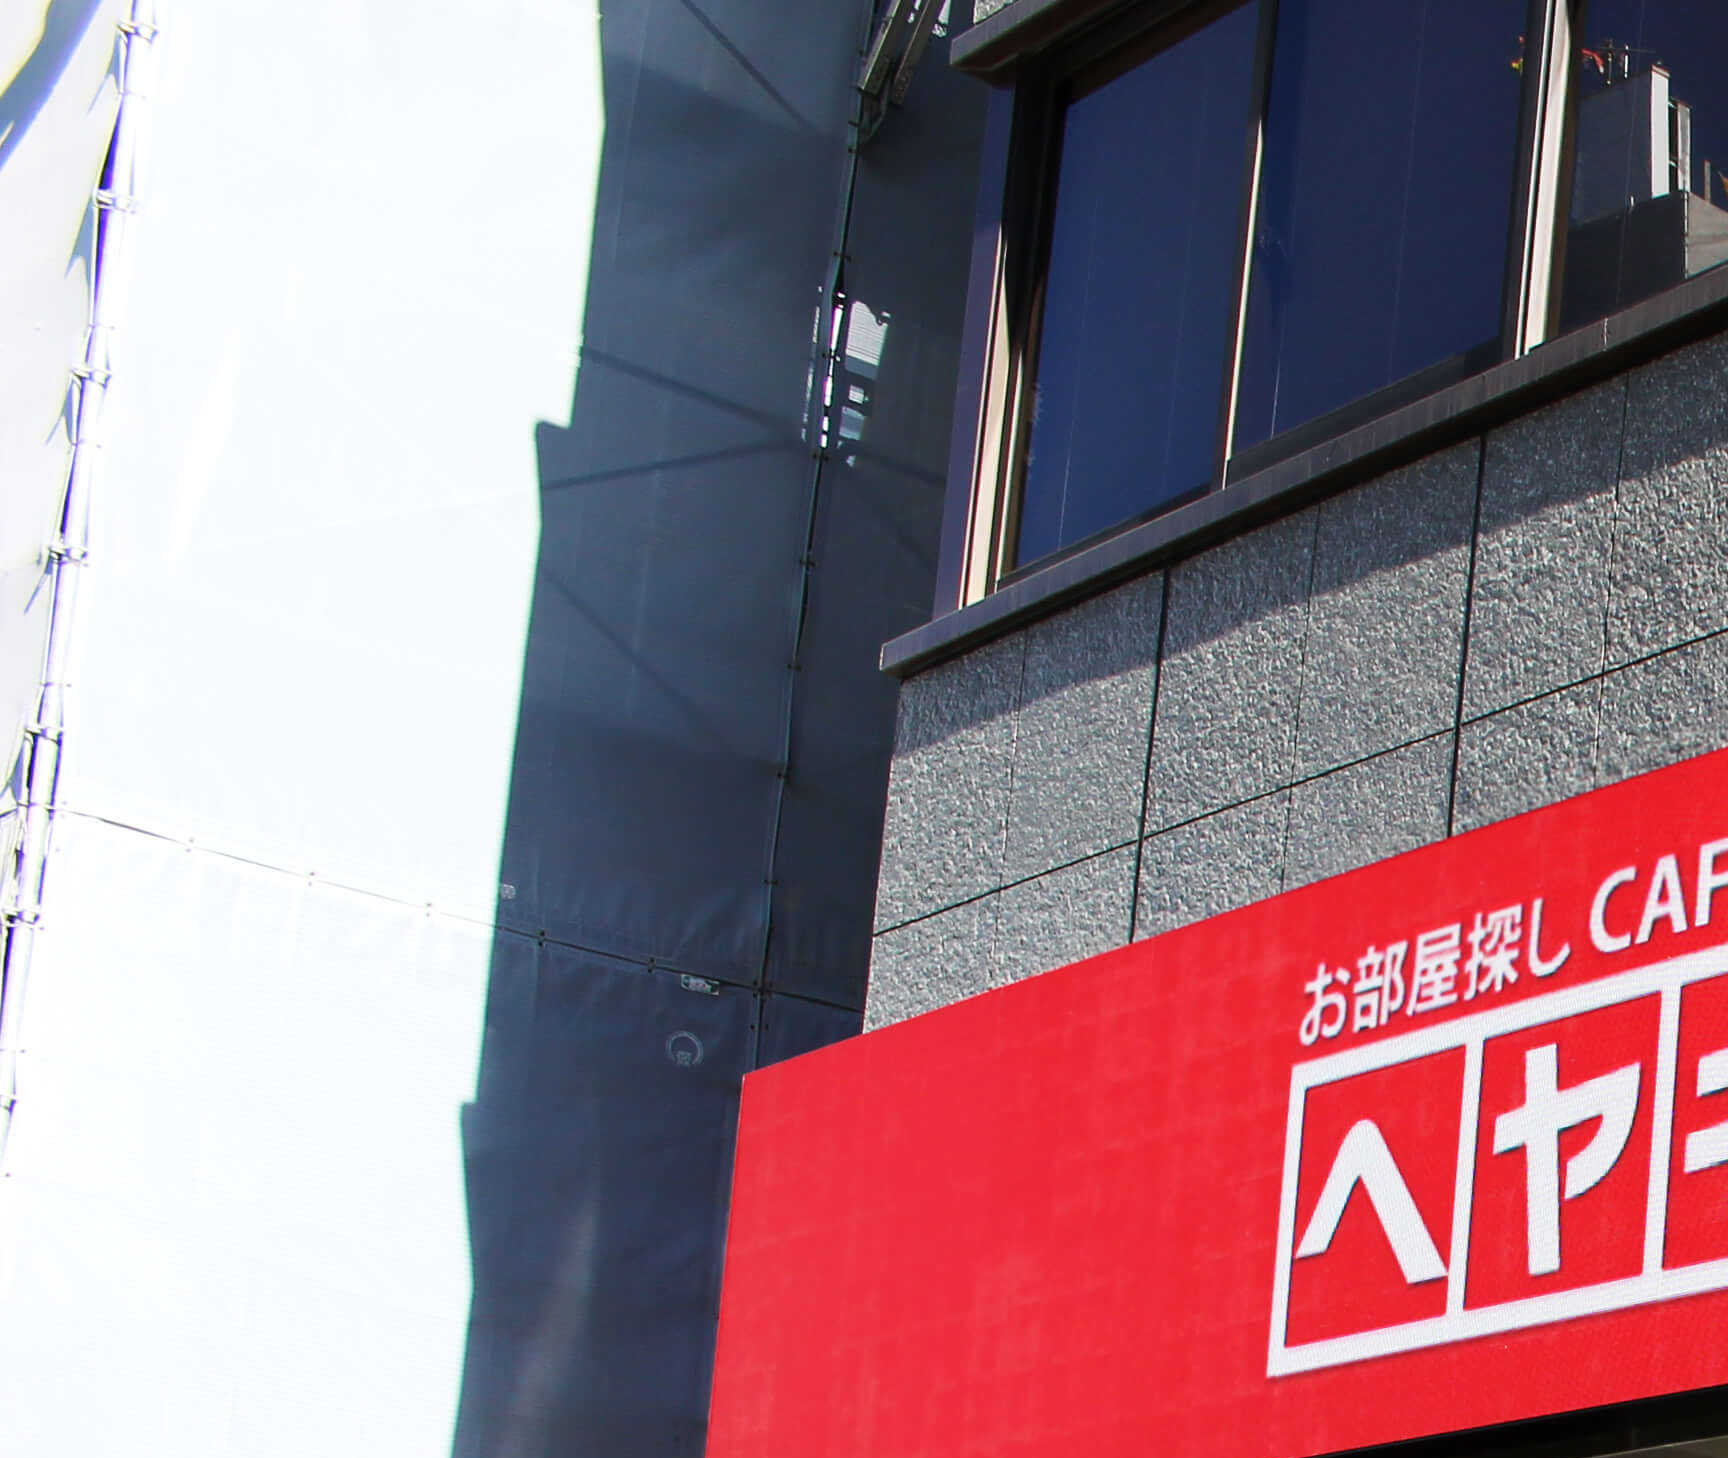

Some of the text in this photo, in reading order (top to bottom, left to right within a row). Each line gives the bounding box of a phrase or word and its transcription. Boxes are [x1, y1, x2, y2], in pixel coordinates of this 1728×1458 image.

[1298, 895, 1575, 1047] お部屋探し
